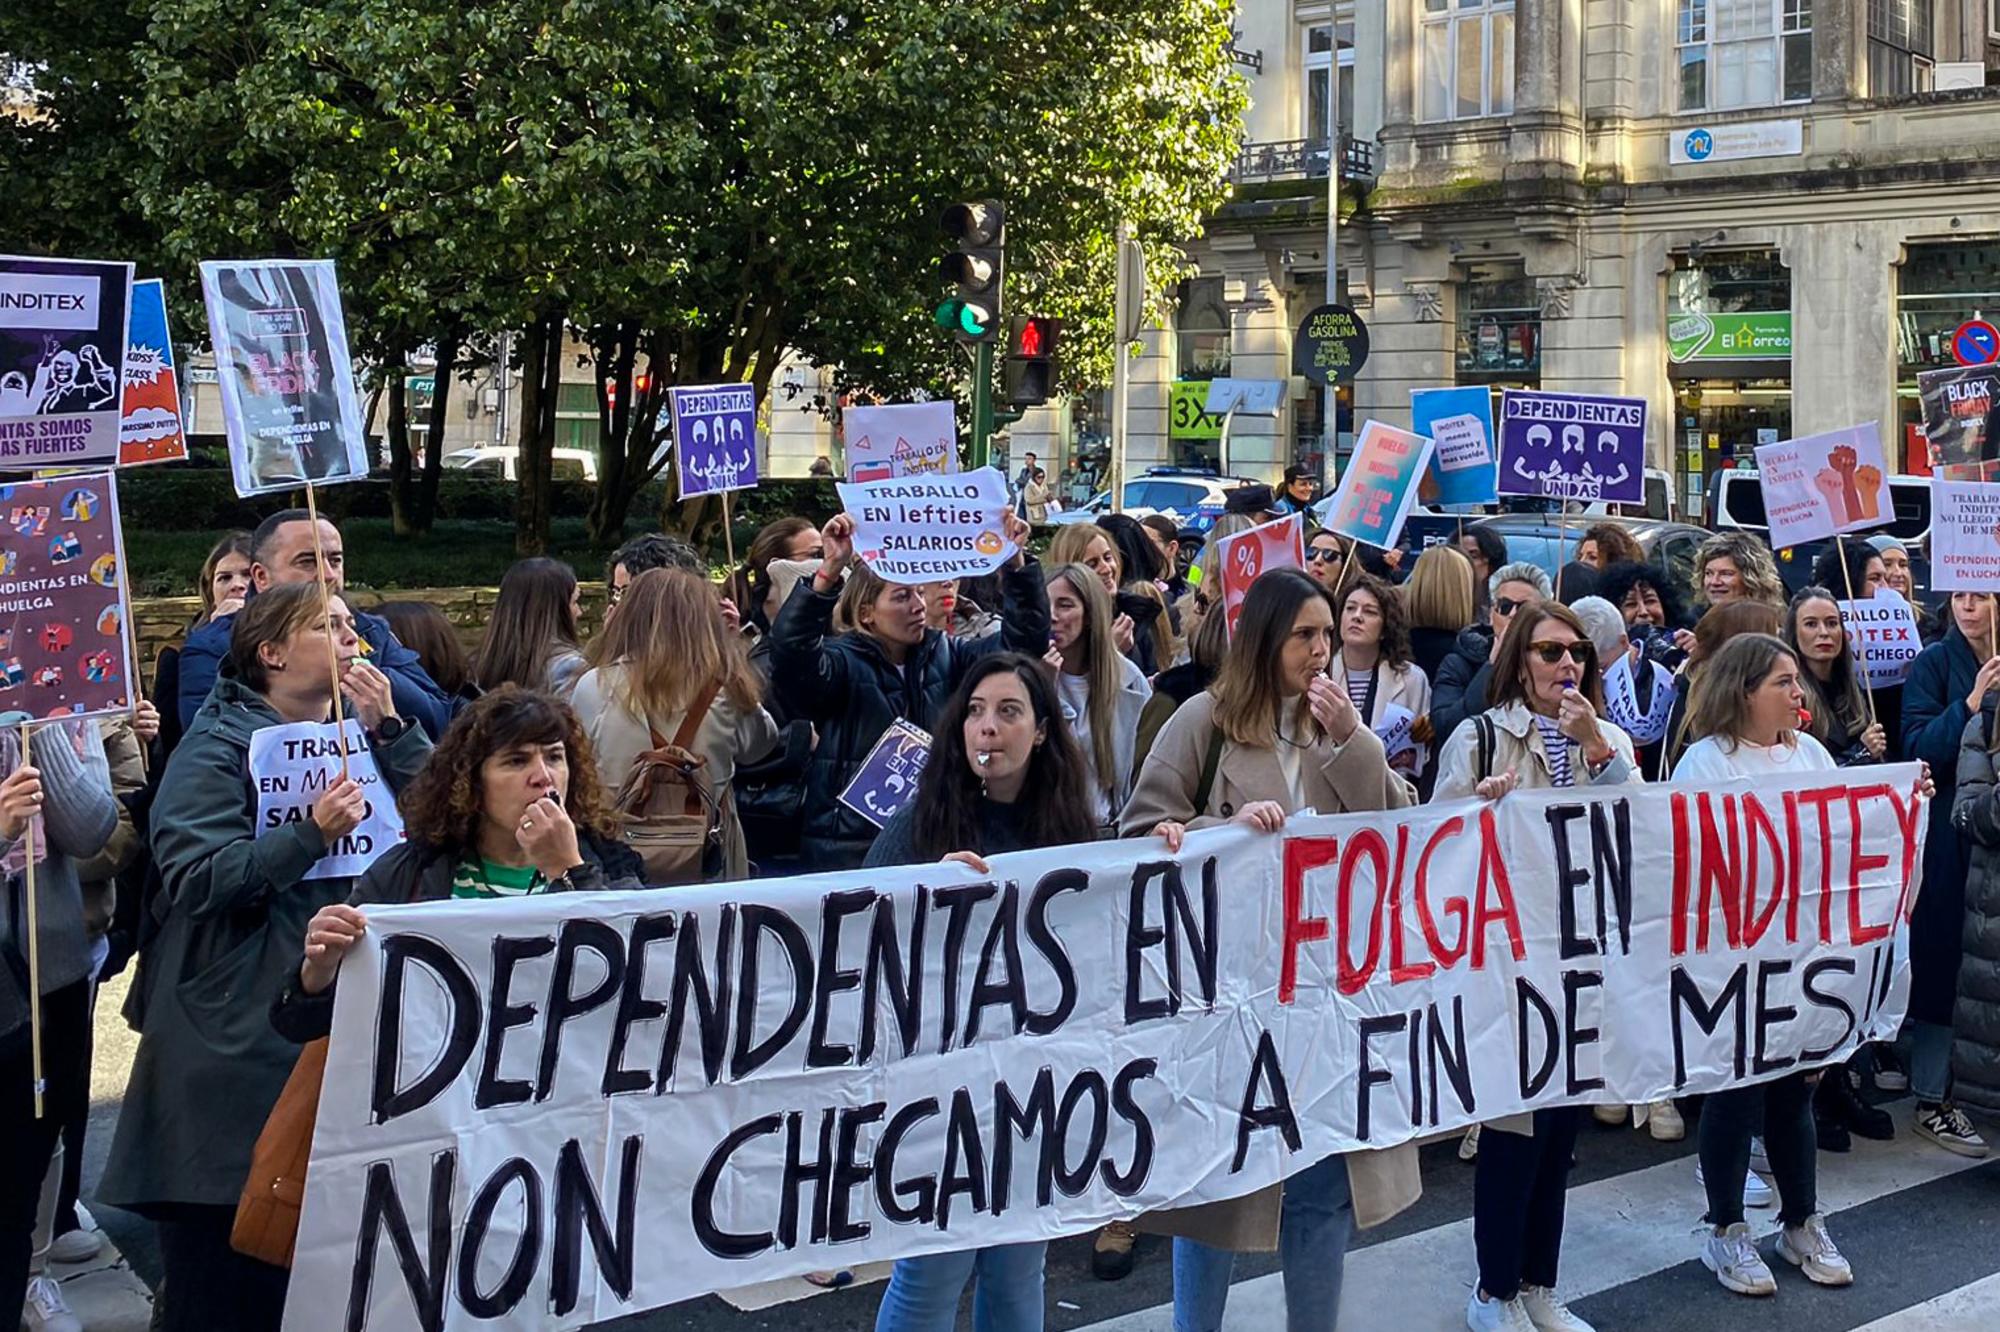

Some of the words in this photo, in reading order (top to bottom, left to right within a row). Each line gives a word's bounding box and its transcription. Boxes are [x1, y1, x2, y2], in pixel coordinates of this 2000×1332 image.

[1, 292, 86, 311] INDITEX
[1312, 313, 1353, 326] AFORRA
[1308, 325, 1358, 338] GASOLINA
[1722, 333, 1735, 348] El
[1737, 328, 1791, 348] Horreo
[249, 350, 320, 374] BLACK
[1947, 380, 1990, 401] BLACK
[679, 393, 752, 415] DEPENDIENTAS
[1508, 400, 1641, 425] DEPENDIENTAS
[1950, 398, 1991, 417] FRIDAY
[40, 418, 92, 436] SOMOS
[25, 436, 86, 455] FUERTES
[865, 485, 979, 499] TRABALLO
[1542, 480, 1600, 498] UNIDAS
[1952, 494, 1999, 504] TRABAJO
[864, 507, 891, 523] EN
[900, 504, 983, 524] lefties
[1958, 514, 1993, 524] LLEGO
[1963, 525, 1978, 535] DE
[883, 536, 974, 551] SALARIOS
[876, 558, 991, 575] INDECENTES
[1956, 570, 1969, 578] EN
[70, 574, 88, 587] EN
[0, 597, 54, 613] HUELGA
[1893, 609, 1910, 621] EN
[1865, 648, 1916, 661] CHEGO
[260, 776, 289, 793] EN
[369, 868, 1090, 1126] DEPENDENTAS
[1124, 856, 1217, 1024] EN
[1276, 807, 1528, 1005] FOLGA
[1546, 797, 1633, 960] EN
[1669, 780, 1924, 957] INDITEX
[344, 1134, 645, 1332] NON
[690, 1056, 1158, 1261] CHEGAMOS
[1229, 1028, 1301, 1175] A
[1355, 995, 1476, 1141] FIN
[1517, 970, 1605, 1100] DE
